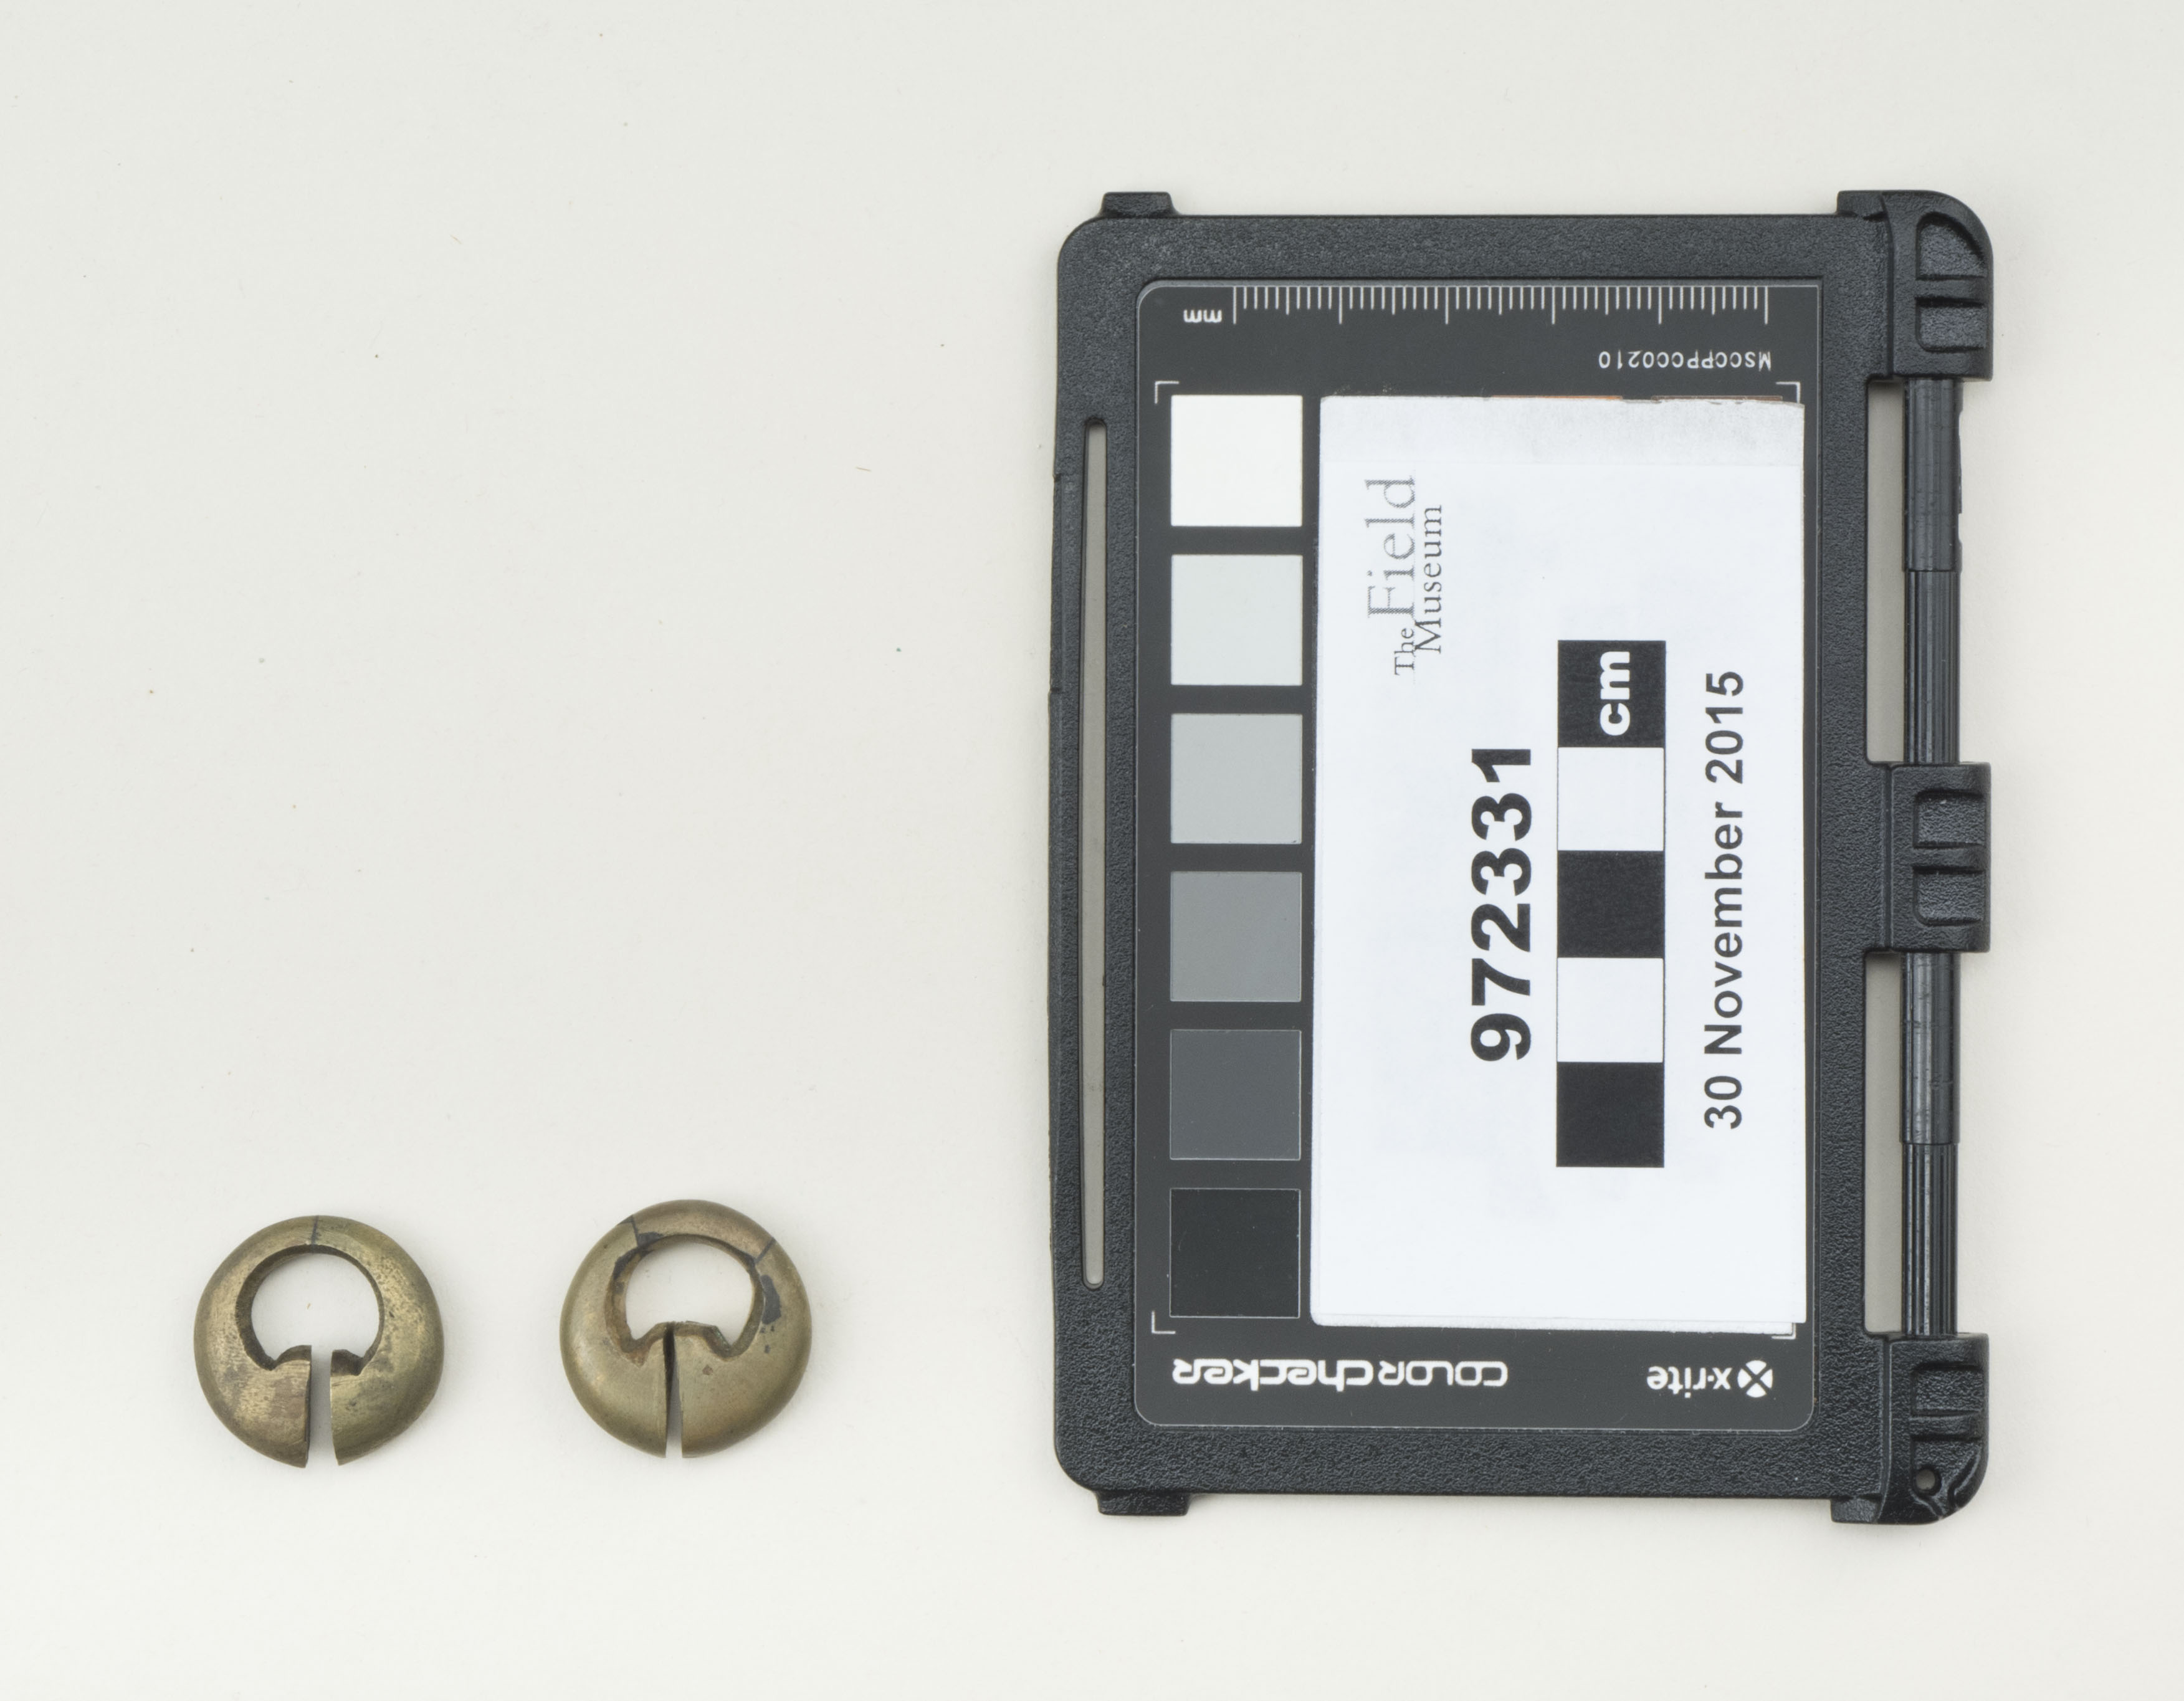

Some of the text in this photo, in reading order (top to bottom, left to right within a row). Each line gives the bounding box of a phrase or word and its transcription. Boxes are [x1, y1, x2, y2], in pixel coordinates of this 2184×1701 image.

[1182, 308, 1224, 325] mm
[1364, 475, 1416, 676] The Field
[1414, 504, 1442, 655] Museum
[1599, 650, 1631, 736] cm
[1470, 748, 1533, 1062] 972331
[1703, 671, 1744, 1130] 30 November 2015
